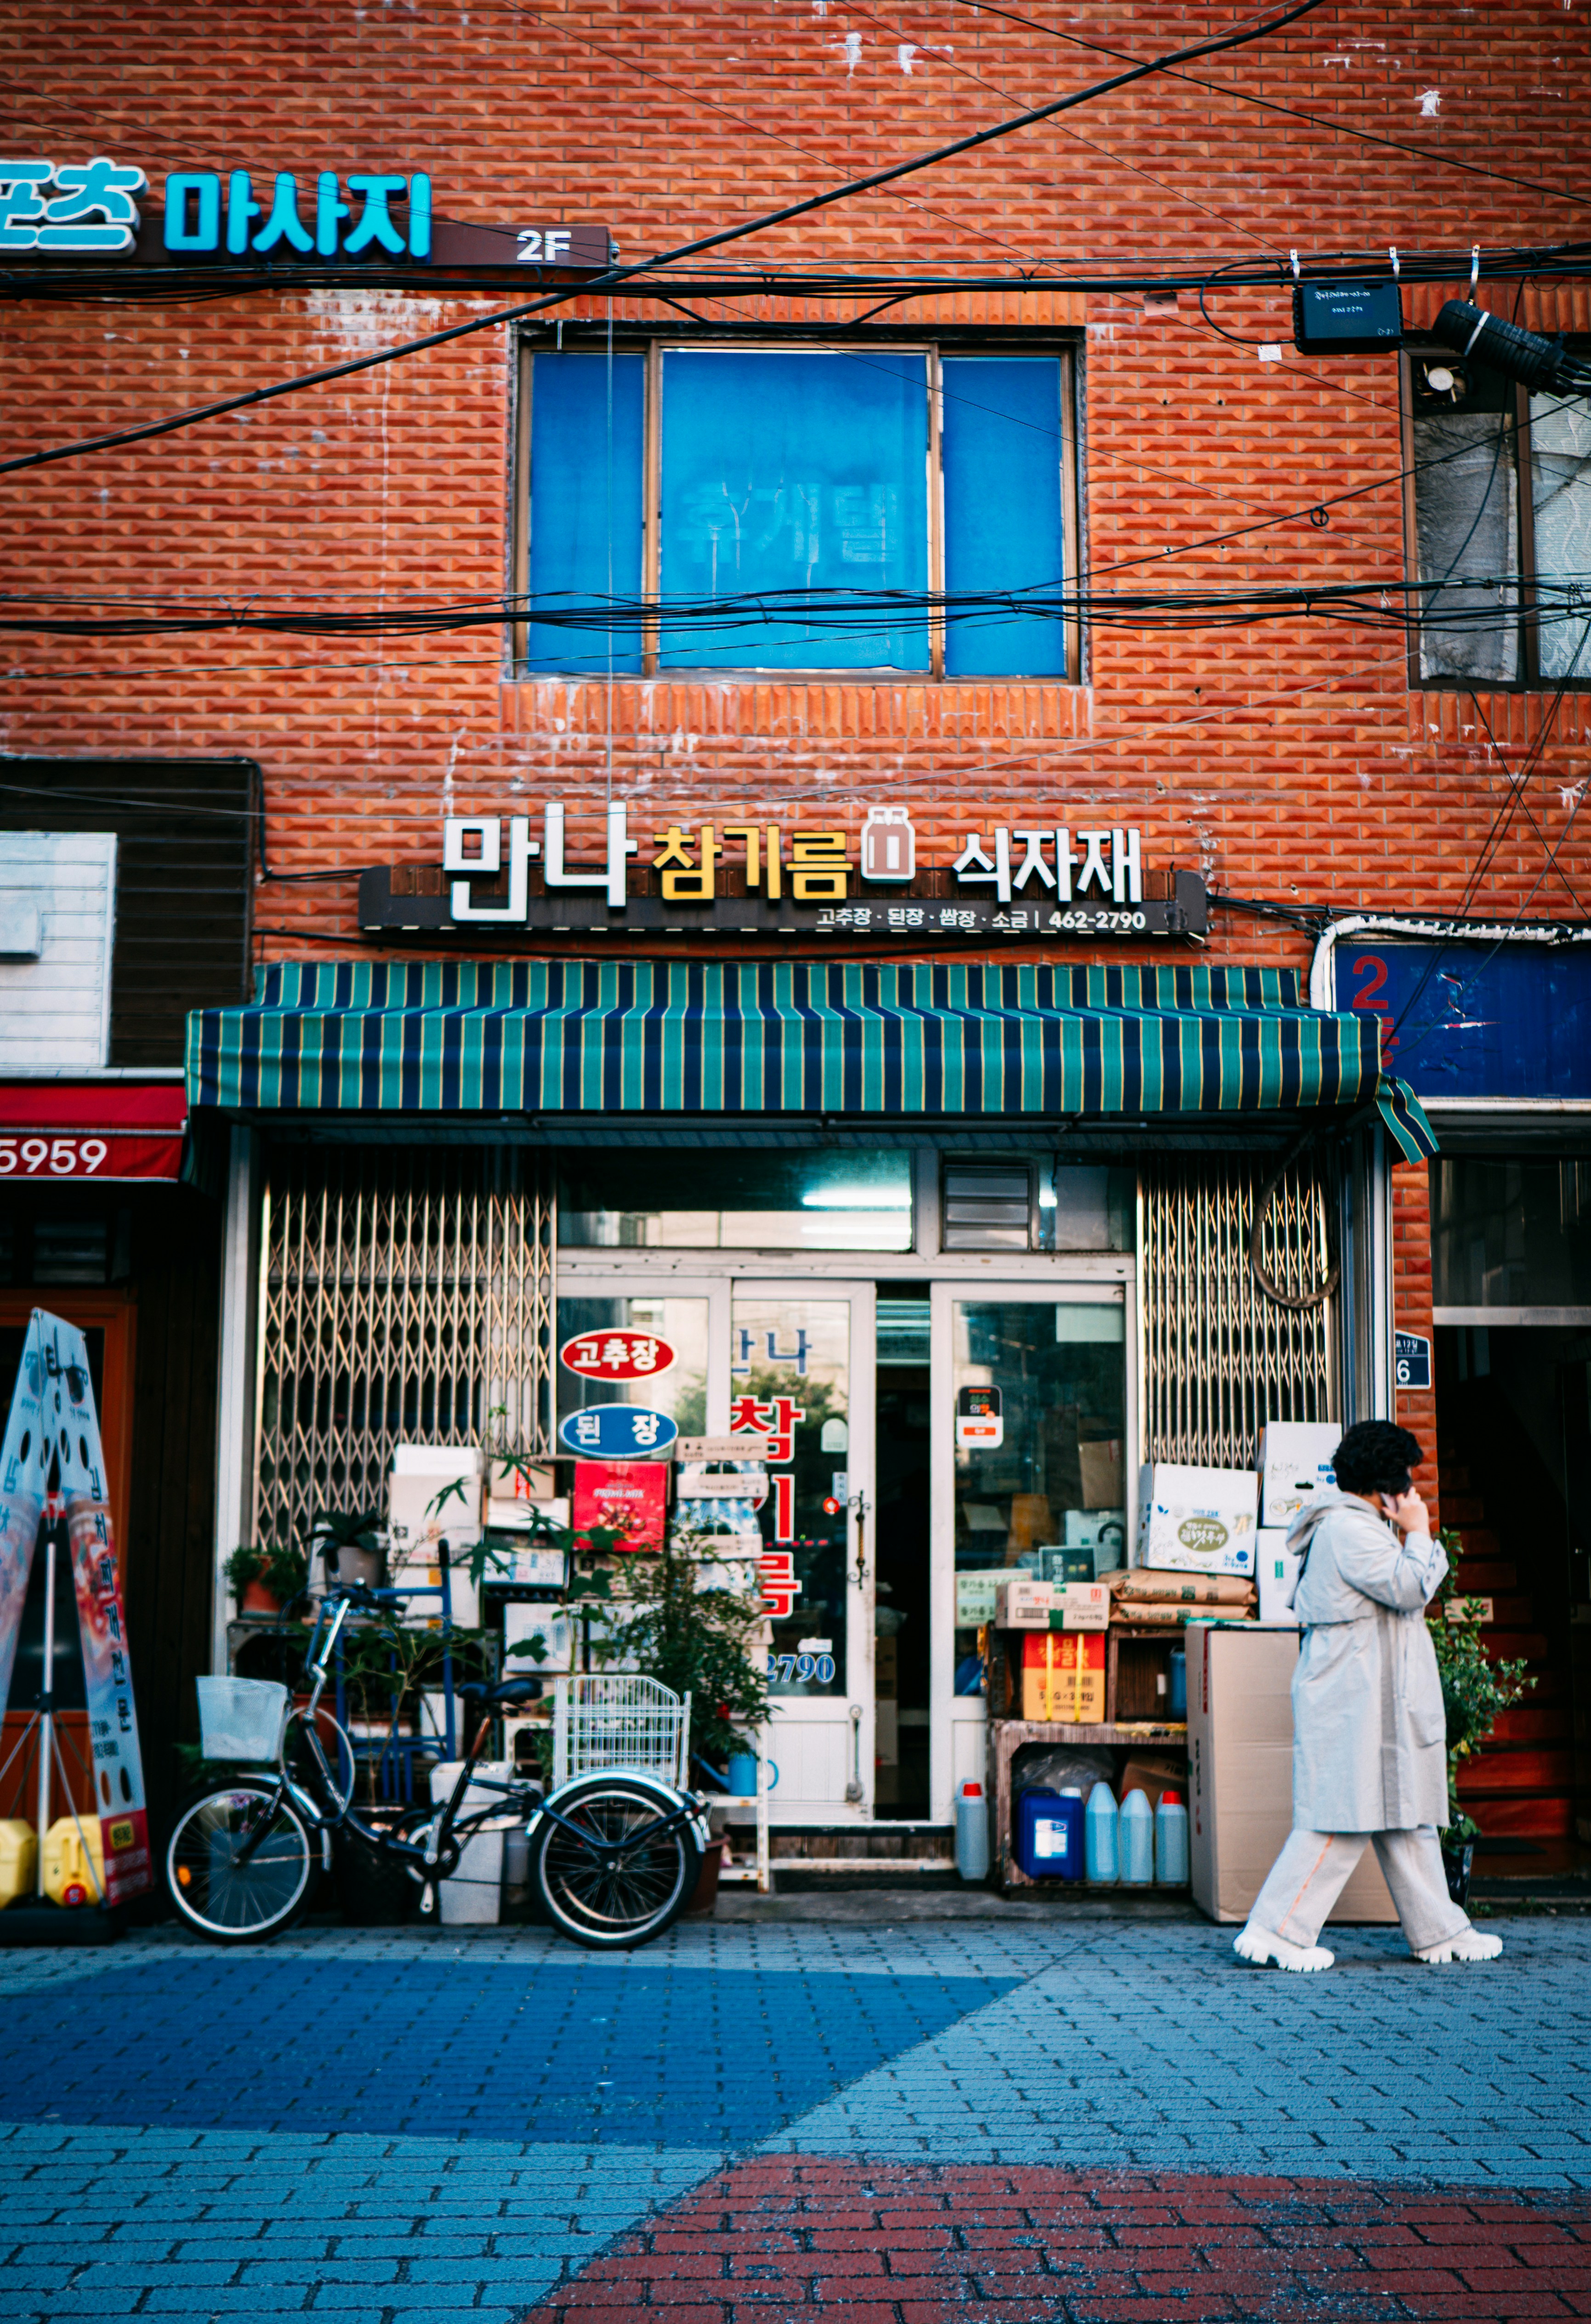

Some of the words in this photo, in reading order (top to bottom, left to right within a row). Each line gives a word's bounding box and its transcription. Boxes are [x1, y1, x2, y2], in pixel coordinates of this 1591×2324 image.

[163, 169, 433, 258] 마사지
[516, 230, 573, 262] 2F
[443, 801, 638, 921] 만나
[652, 825, 853, 900] 참기름
[952, 827, 1142, 903] 식자재
[817, 908, 872, 926] 고추장
[887, 908, 925, 926] 된장
[939, 909, 976, 928] 쌈장
[992, 911, 1028, 928] 소금
[1049, 911, 1146, 929] 462-2790
[573, 1338, 659, 1371] 고추장
[1397, 1359, 1410, 1383] 6
